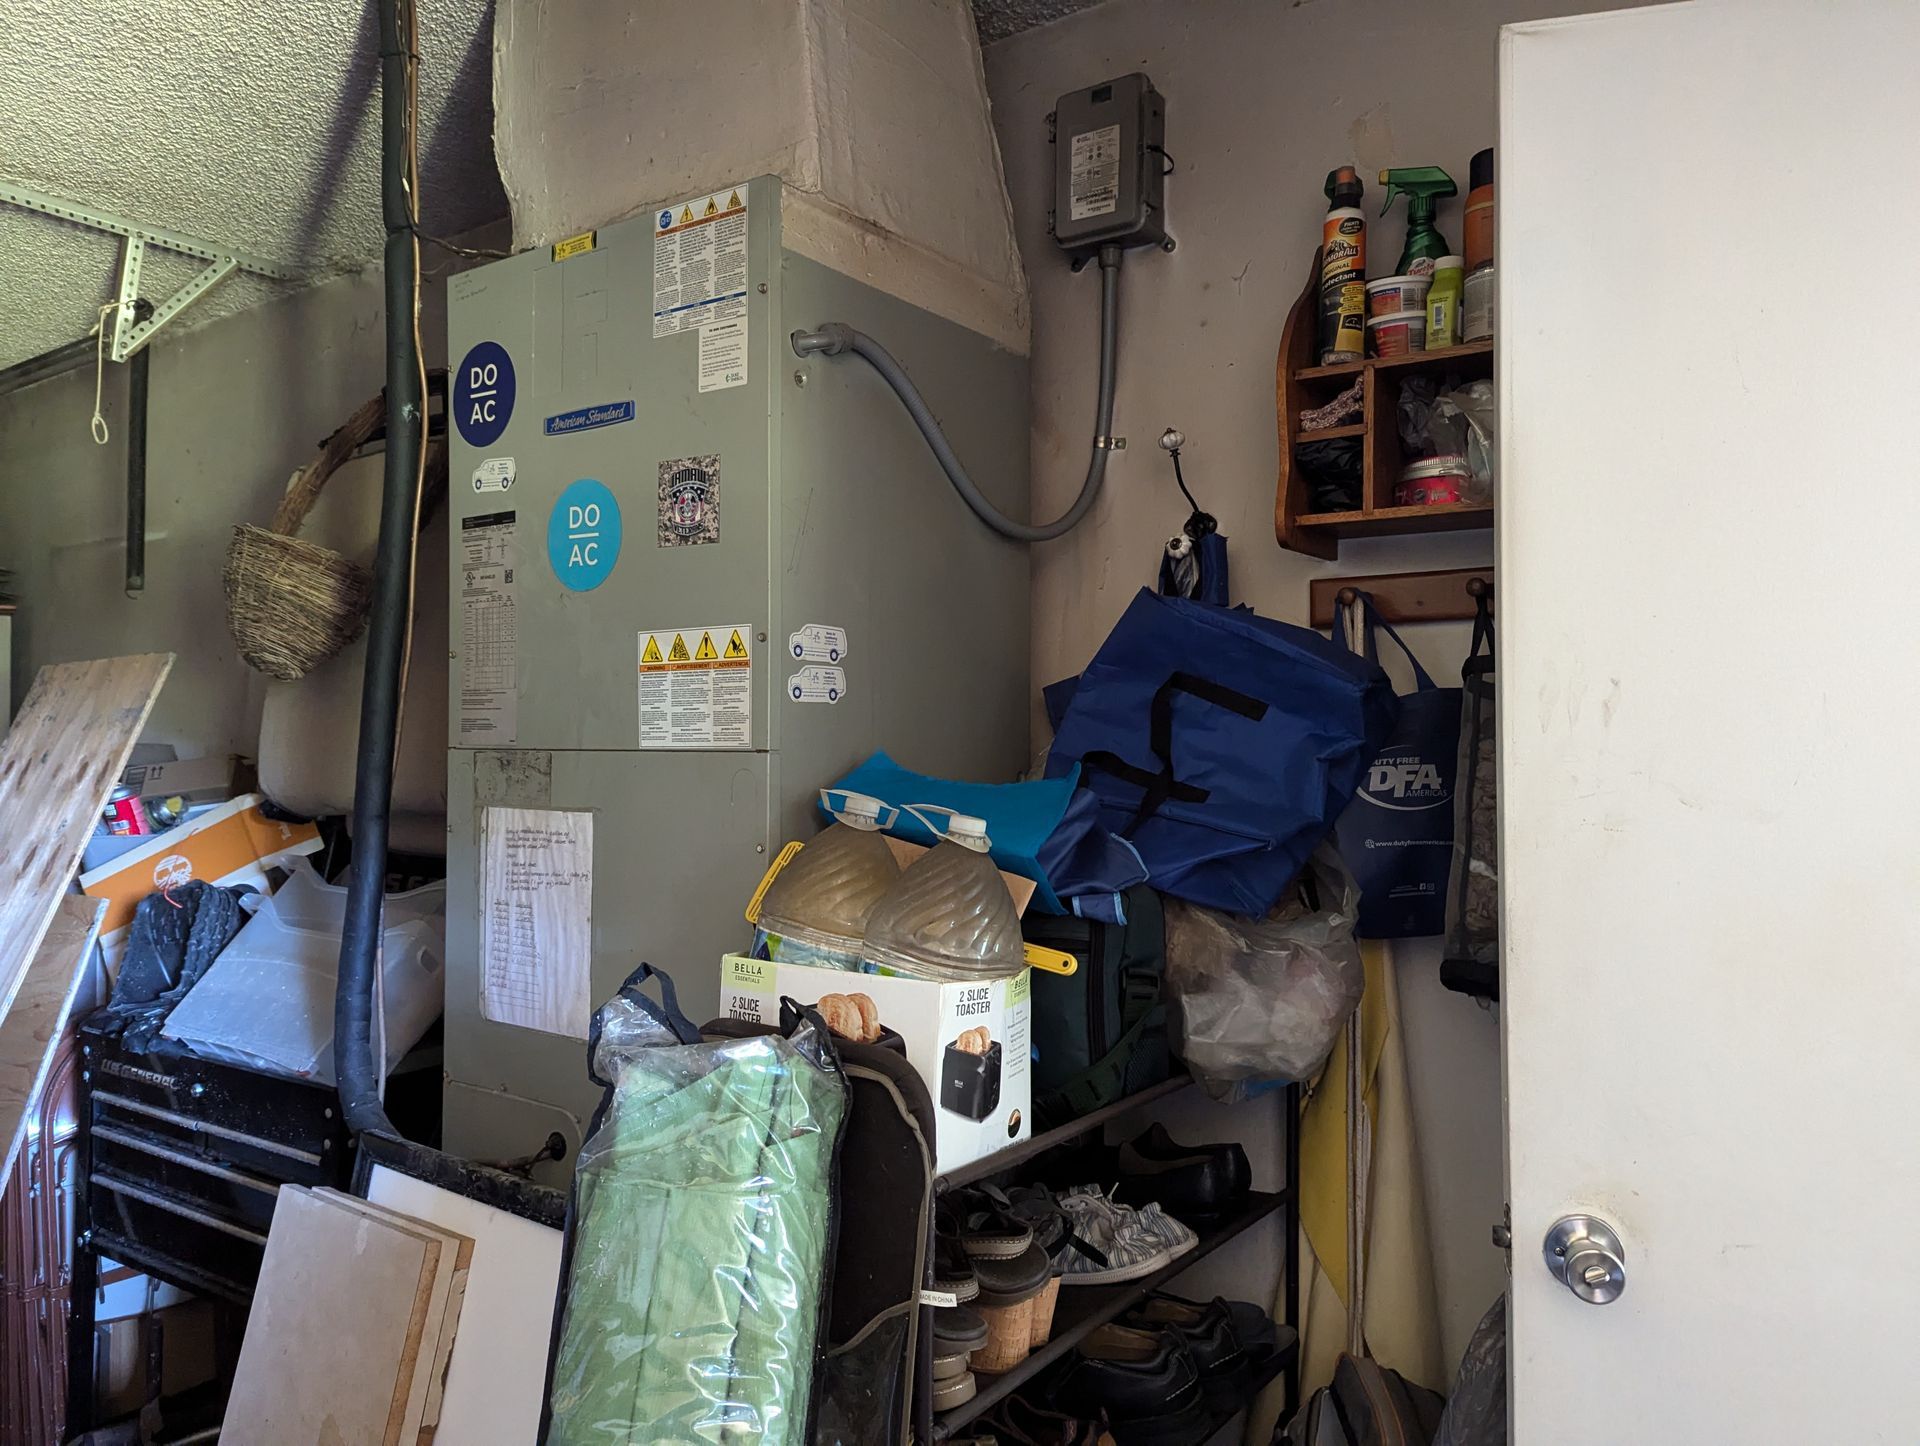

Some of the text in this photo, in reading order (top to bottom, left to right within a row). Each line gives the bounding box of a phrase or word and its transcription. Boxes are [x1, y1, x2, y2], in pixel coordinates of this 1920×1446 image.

[1322, 272, 1356, 291] rotectant
[470, 363, 498, 390] DO
[469, 400, 497, 425] AC
[550, 403, 627, 432] American Standard
[568, 503, 601, 529] DO
[568, 542, 599, 568] AC
[1396, 756, 1421, 764] FREE
[1368, 764, 1442, 798] DFA
[1405, 789, 1447, 798] AMERICAS
[734, 962, 762, 975] BELLA
[735, 975, 760, 984] ESSENTIALS
[1014, 974, 1028, 989] BELLA
[959, 987, 989, 1002] 2 SLICE
[732, 996, 760, 1012] 2 SLICE
[955, 1001, 991, 1017] TOASTER
[729, 1009, 761, 1024] TOASTER
[938, 1296, 953, 1304] CHINA
